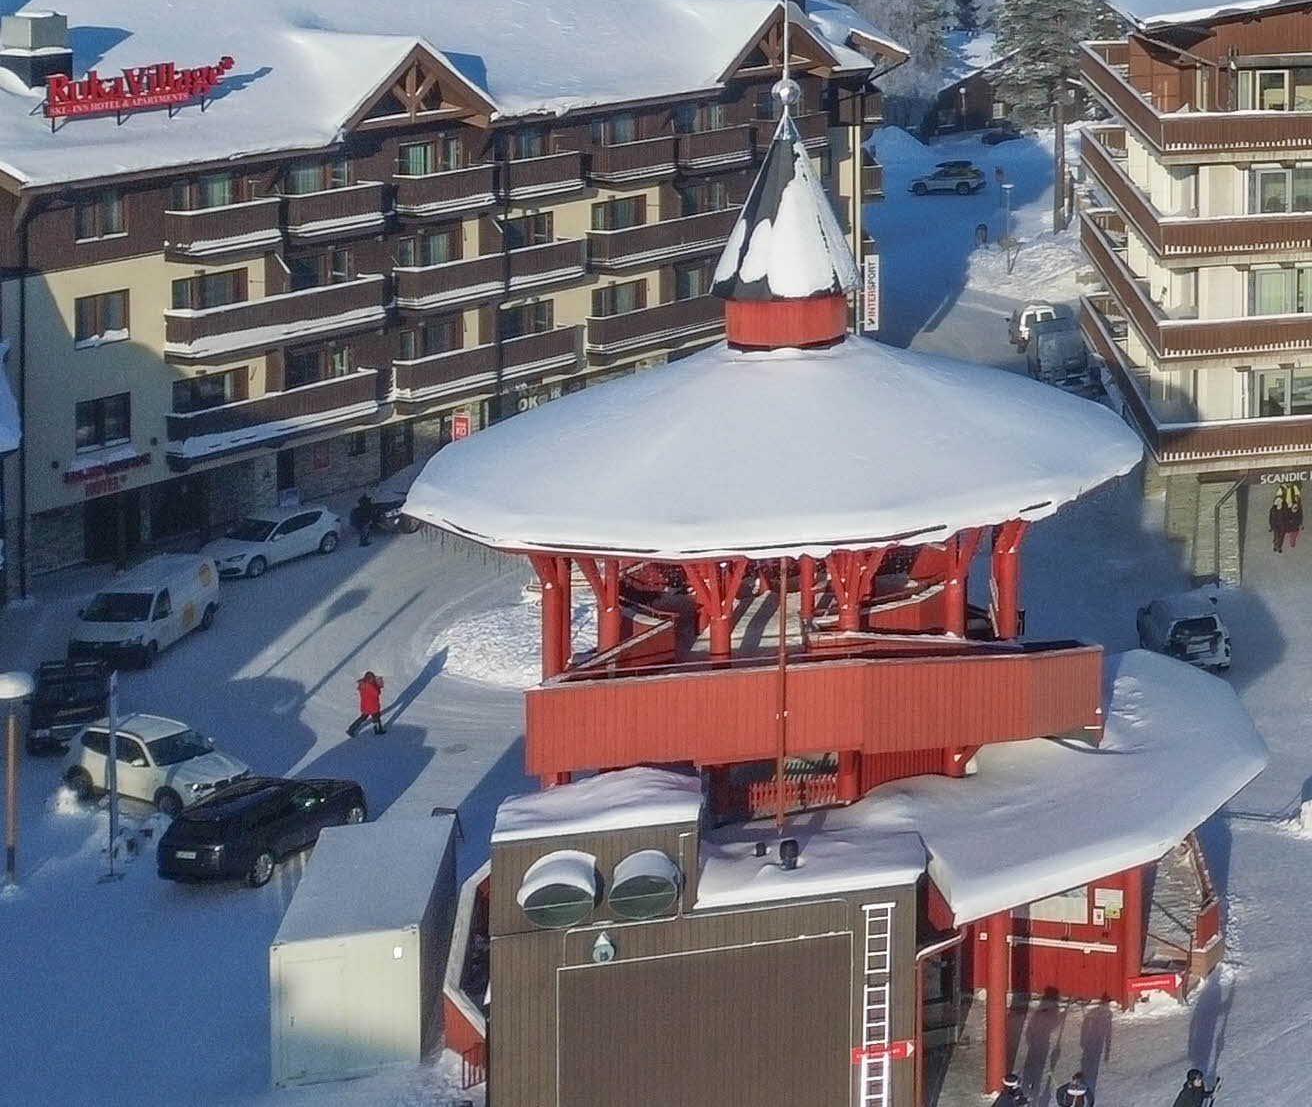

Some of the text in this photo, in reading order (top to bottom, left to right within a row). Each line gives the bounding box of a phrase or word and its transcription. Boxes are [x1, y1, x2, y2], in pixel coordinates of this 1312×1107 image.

[90, 99, 120, 111] HOTEL
[132, 92, 189, 105] APARTMENTS
[867, 261, 876, 317] INTERSPORT
[1260, 471, 1307, 485] SCANDIC
